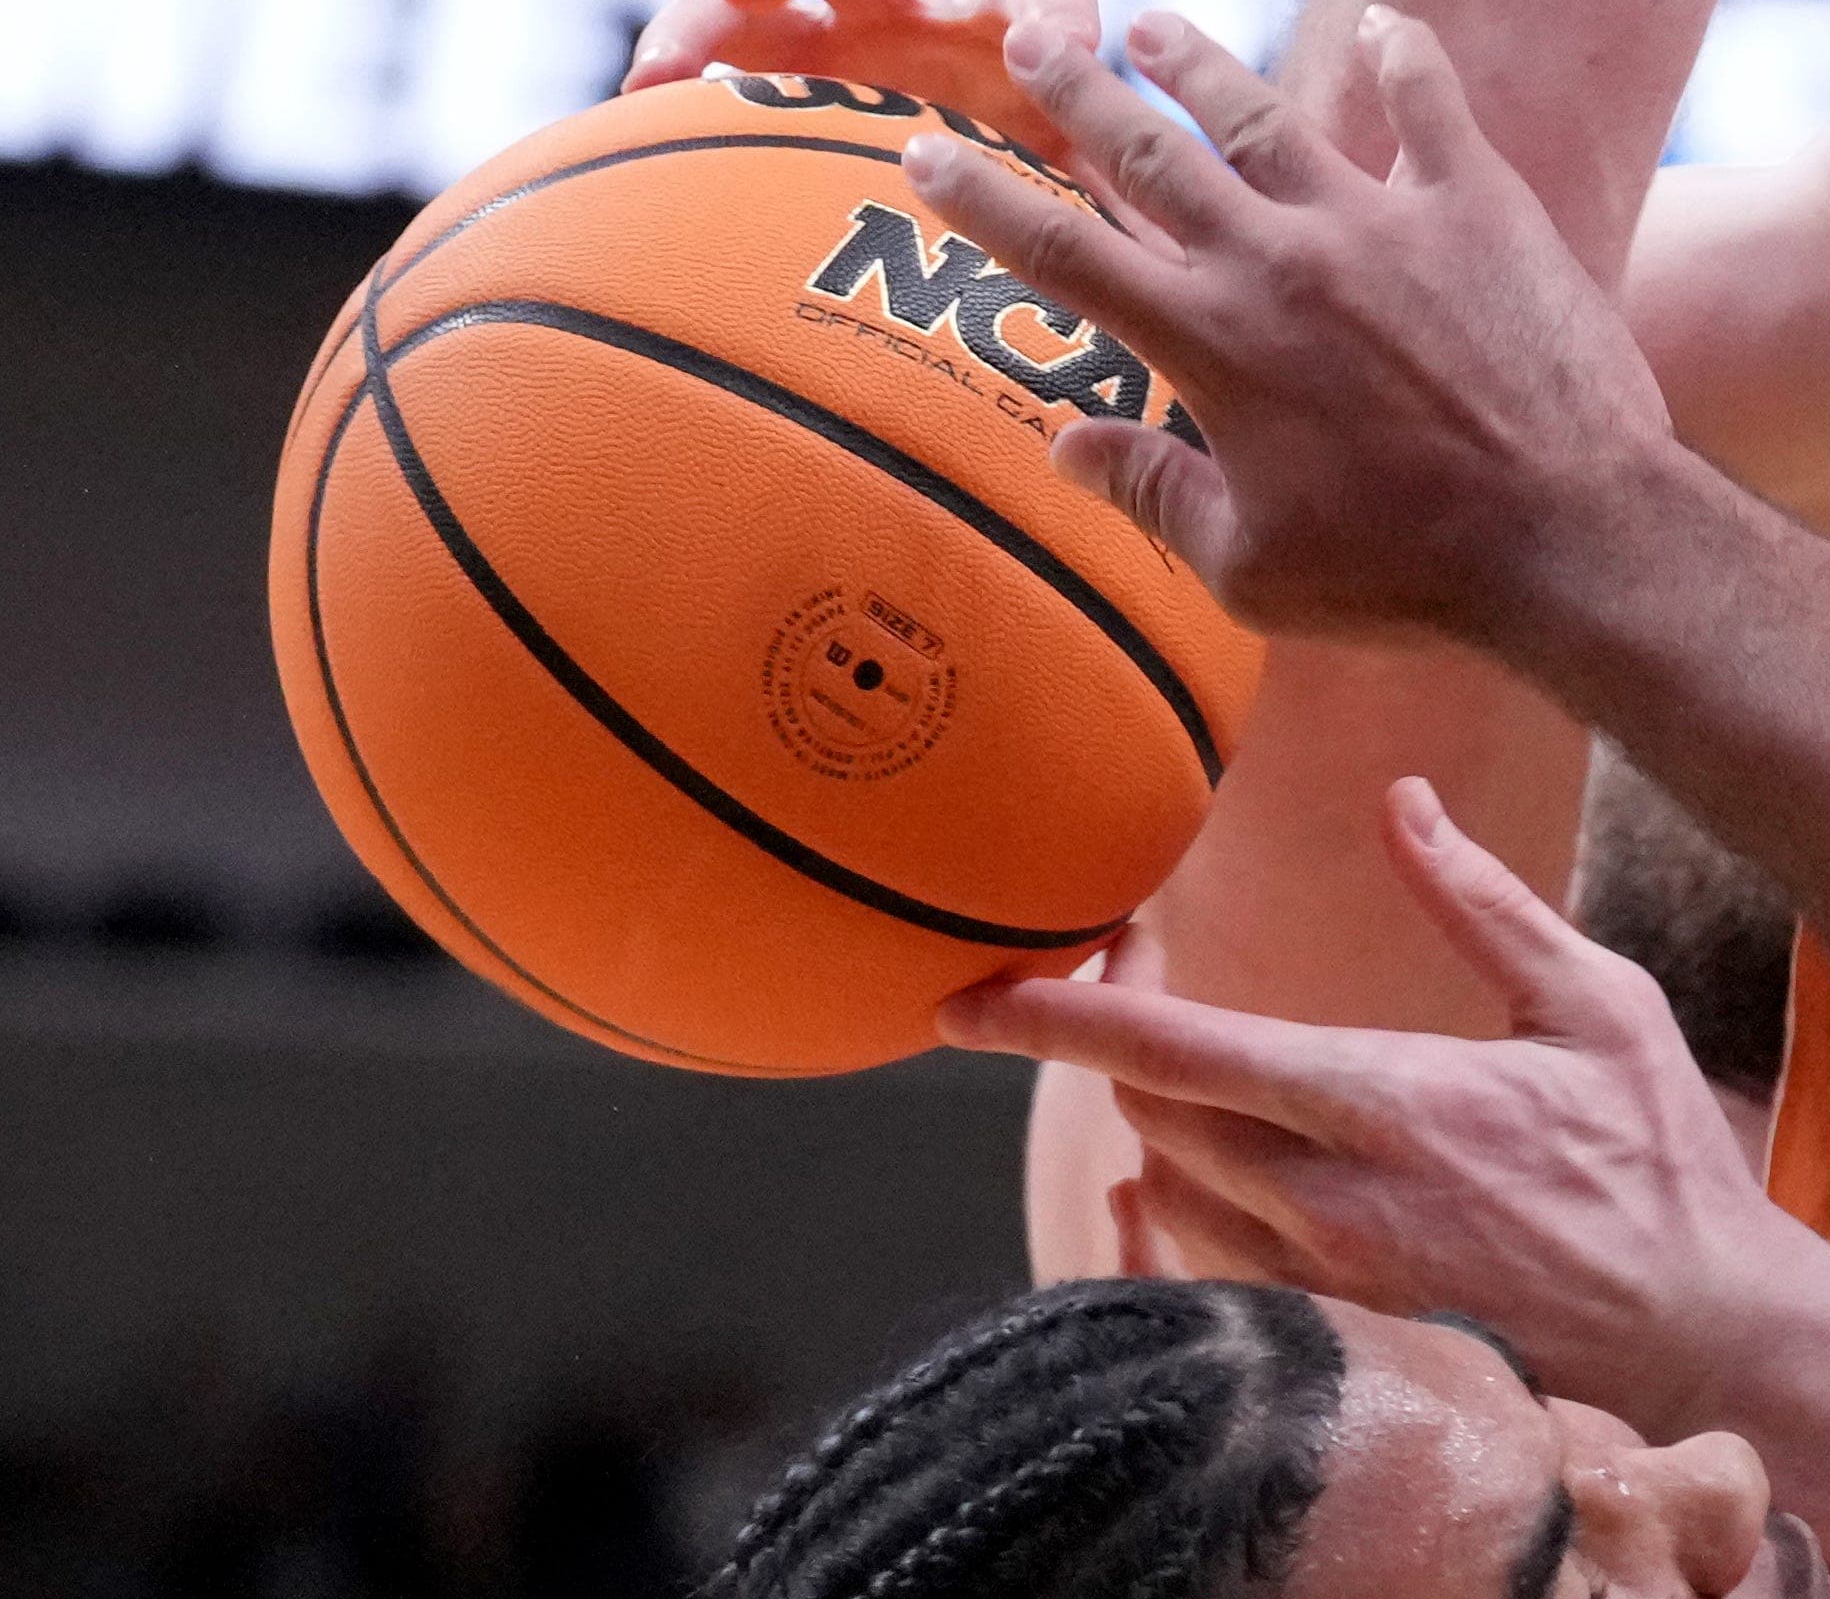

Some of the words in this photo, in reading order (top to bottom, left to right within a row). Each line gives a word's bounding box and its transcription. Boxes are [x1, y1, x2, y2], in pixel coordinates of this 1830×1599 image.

[796, 302, 984, 396] OFFICIAL
[996, 393, 1059, 443] GA
[804, 199, 1211, 458] NCA
[867, 600, 918, 641] SIZE
